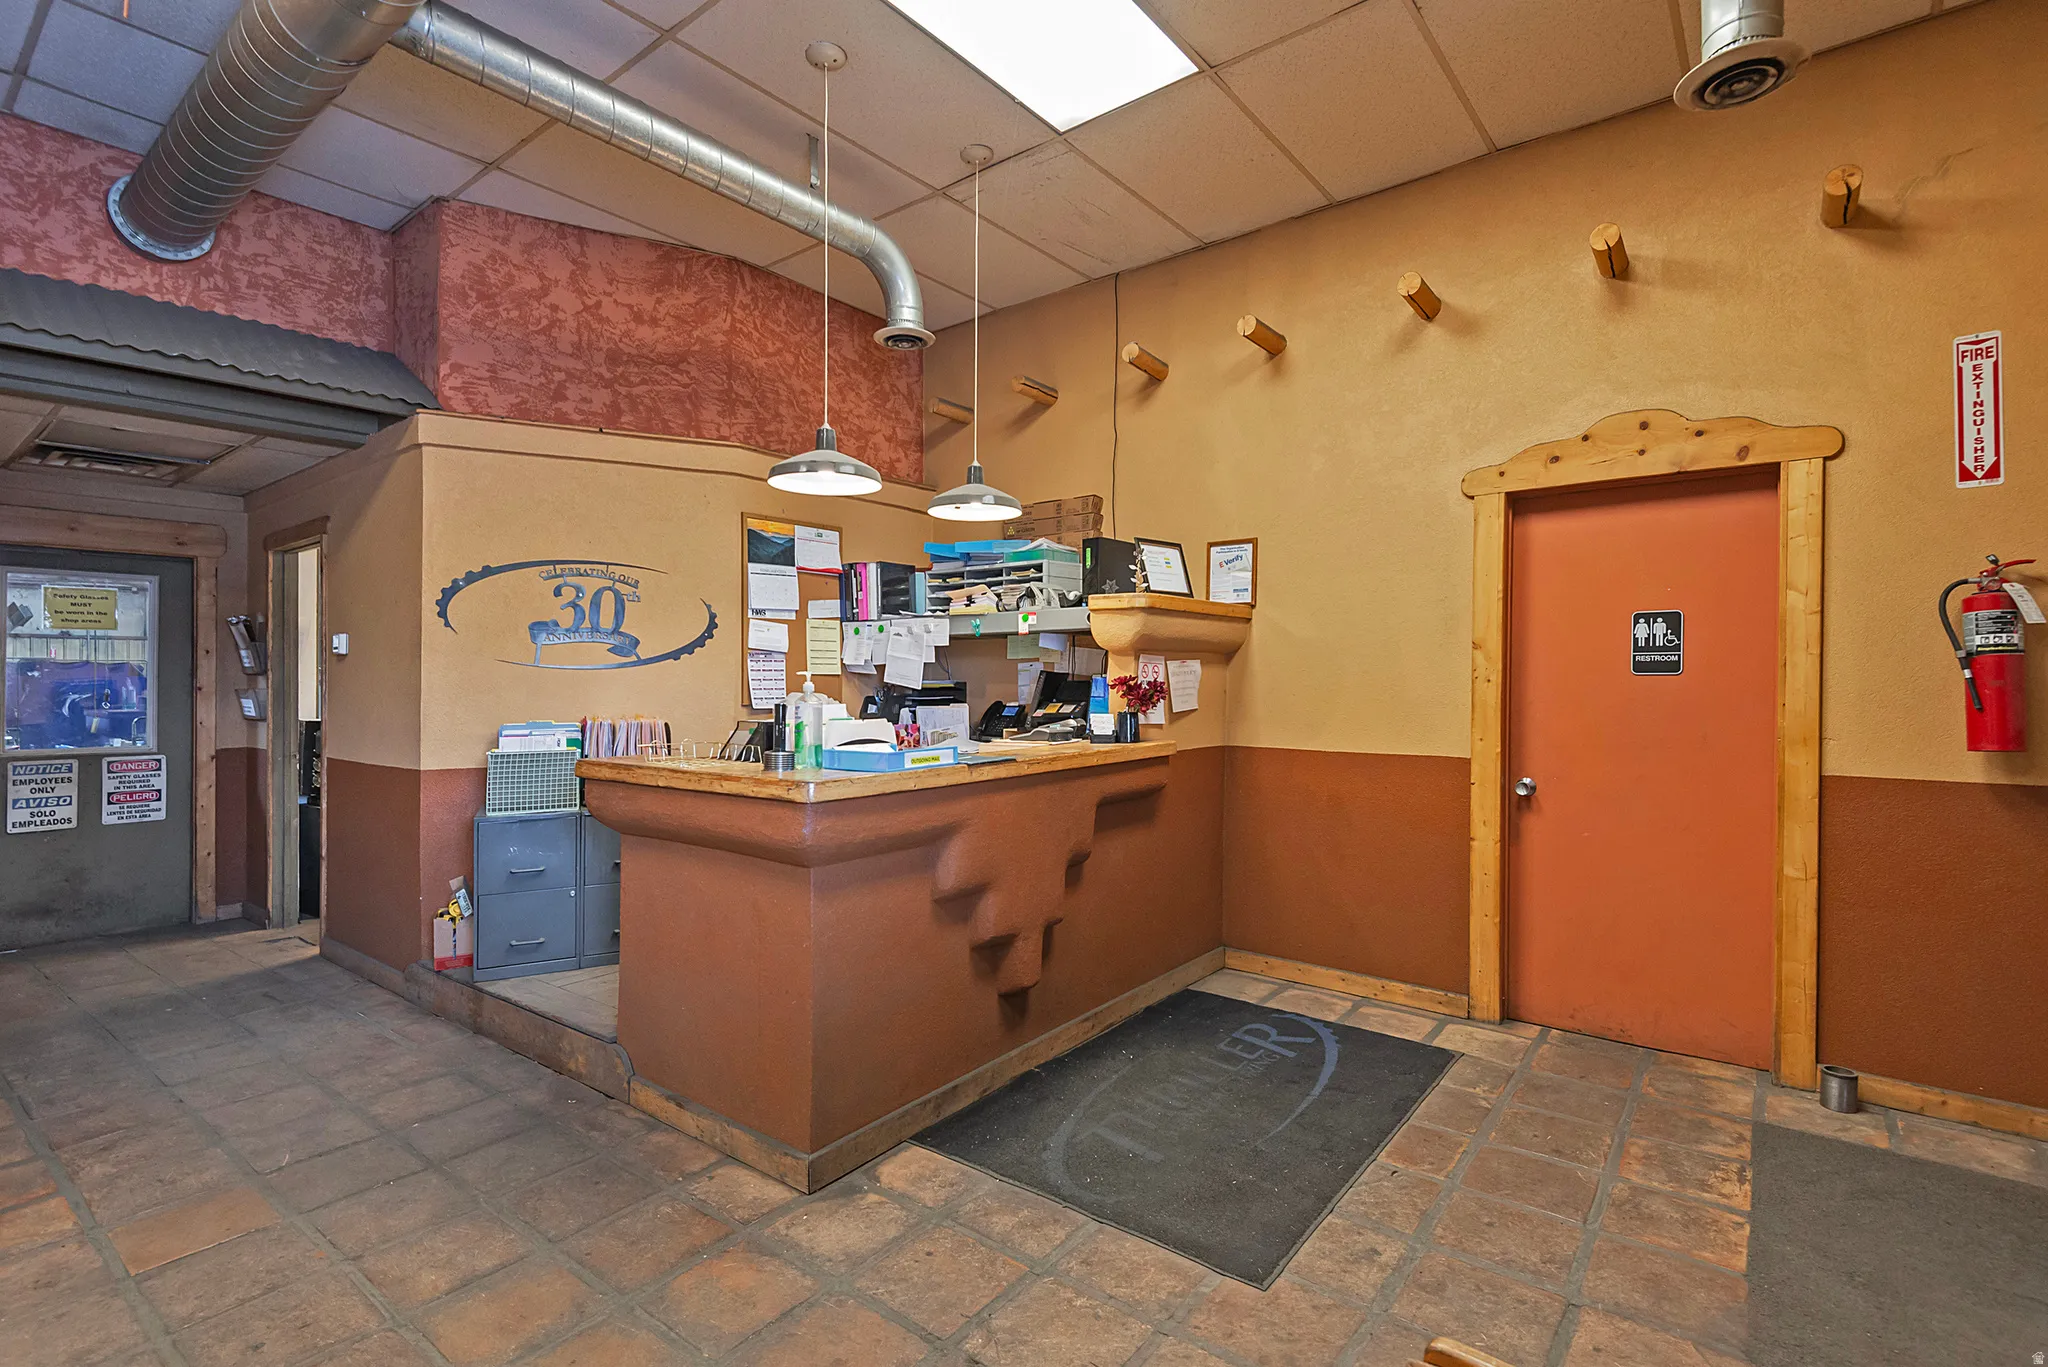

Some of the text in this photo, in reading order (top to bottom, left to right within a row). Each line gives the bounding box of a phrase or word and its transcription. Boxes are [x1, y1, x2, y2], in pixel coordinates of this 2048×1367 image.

[1961, 345, 1995, 363] FIRE
[1972, 363, 1985, 473] EXTINGUISHER
[539, 567, 640, 588] CELEBRATING OUR
[543, 631, 633, 646] ANNIVERSARY
[14, 763, 71, 775] NOTICE
[113, 761, 156, 770] DANGER
[12, 776, 73, 786] EMPLOYEES
[29, 786, 56, 794] ONLY
[14, 796, 71, 808] AVISO
[113, 792, 156, 802] PELIGRO
[12, 817, 73, 829] EMPLEADOS
